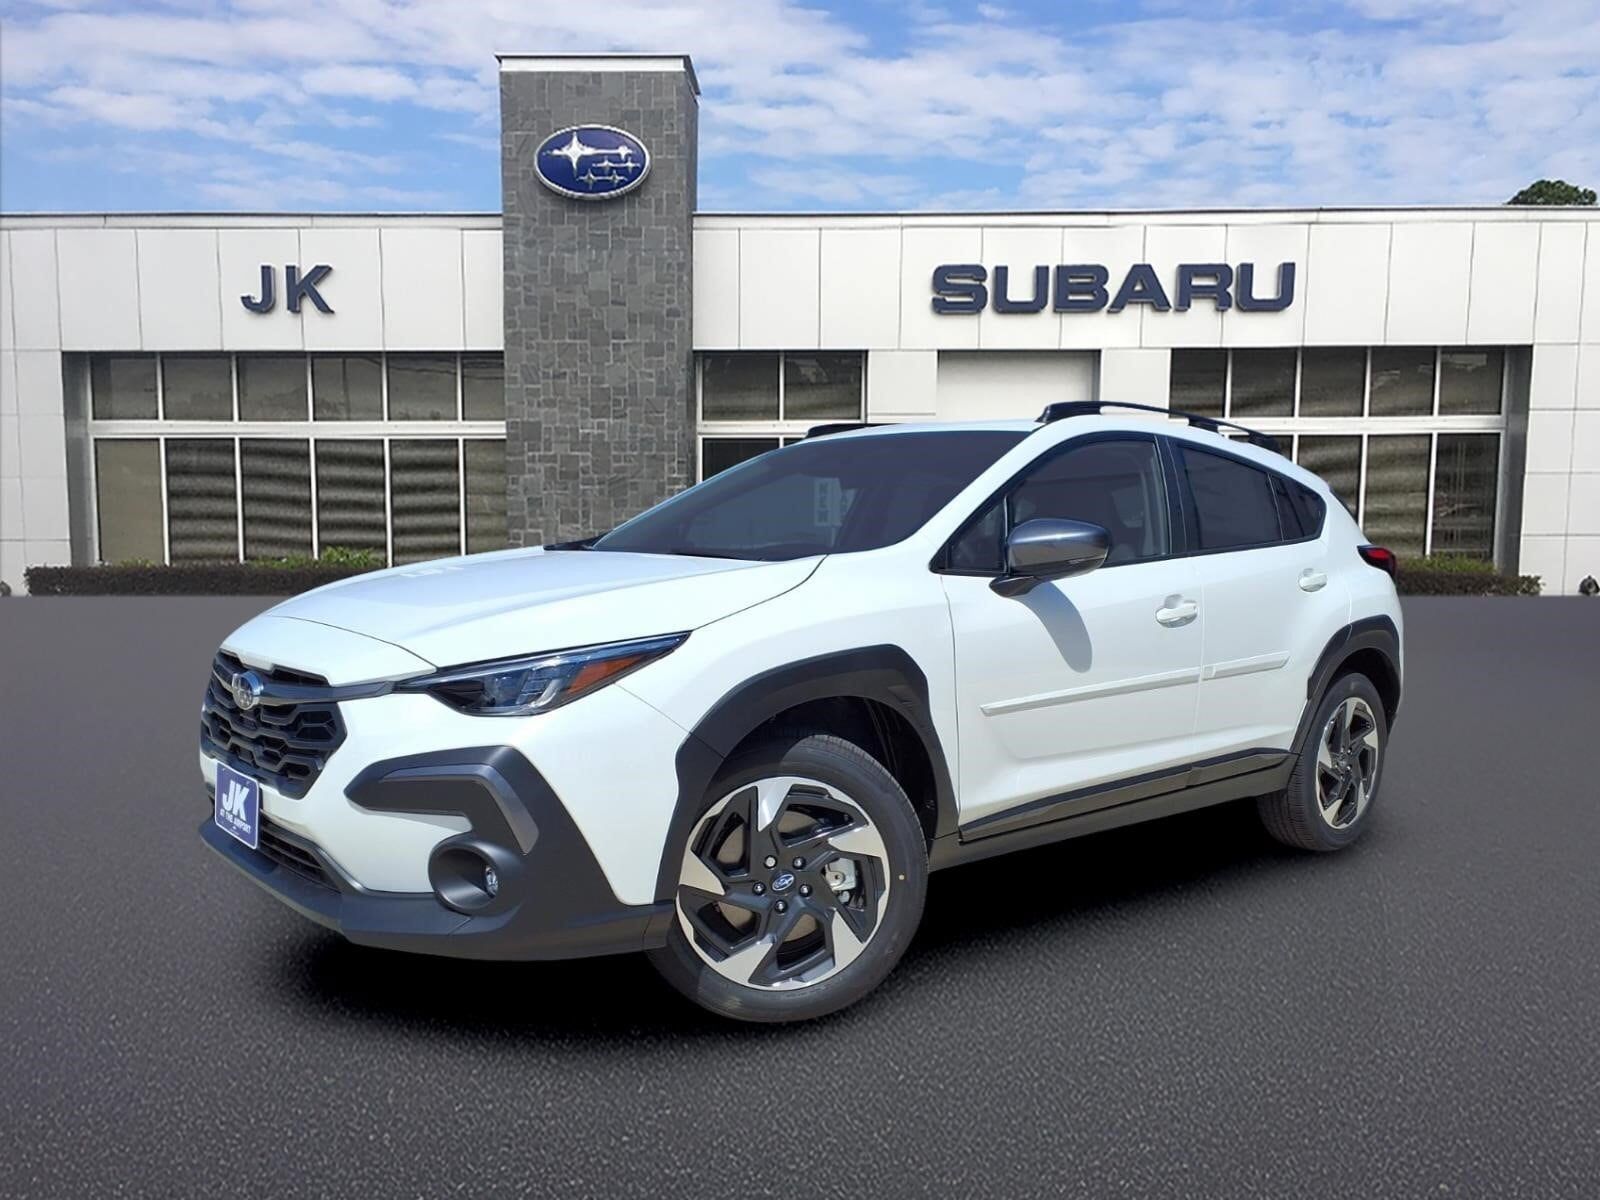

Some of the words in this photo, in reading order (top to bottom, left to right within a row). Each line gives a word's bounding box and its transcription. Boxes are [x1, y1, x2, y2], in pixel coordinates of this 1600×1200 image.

[241, 265, 335, 314] JK
[931, 262, 1296, 314] SUBARU
[222, 780, 250, 822] JK
[225, 811, 233, 823] THE
